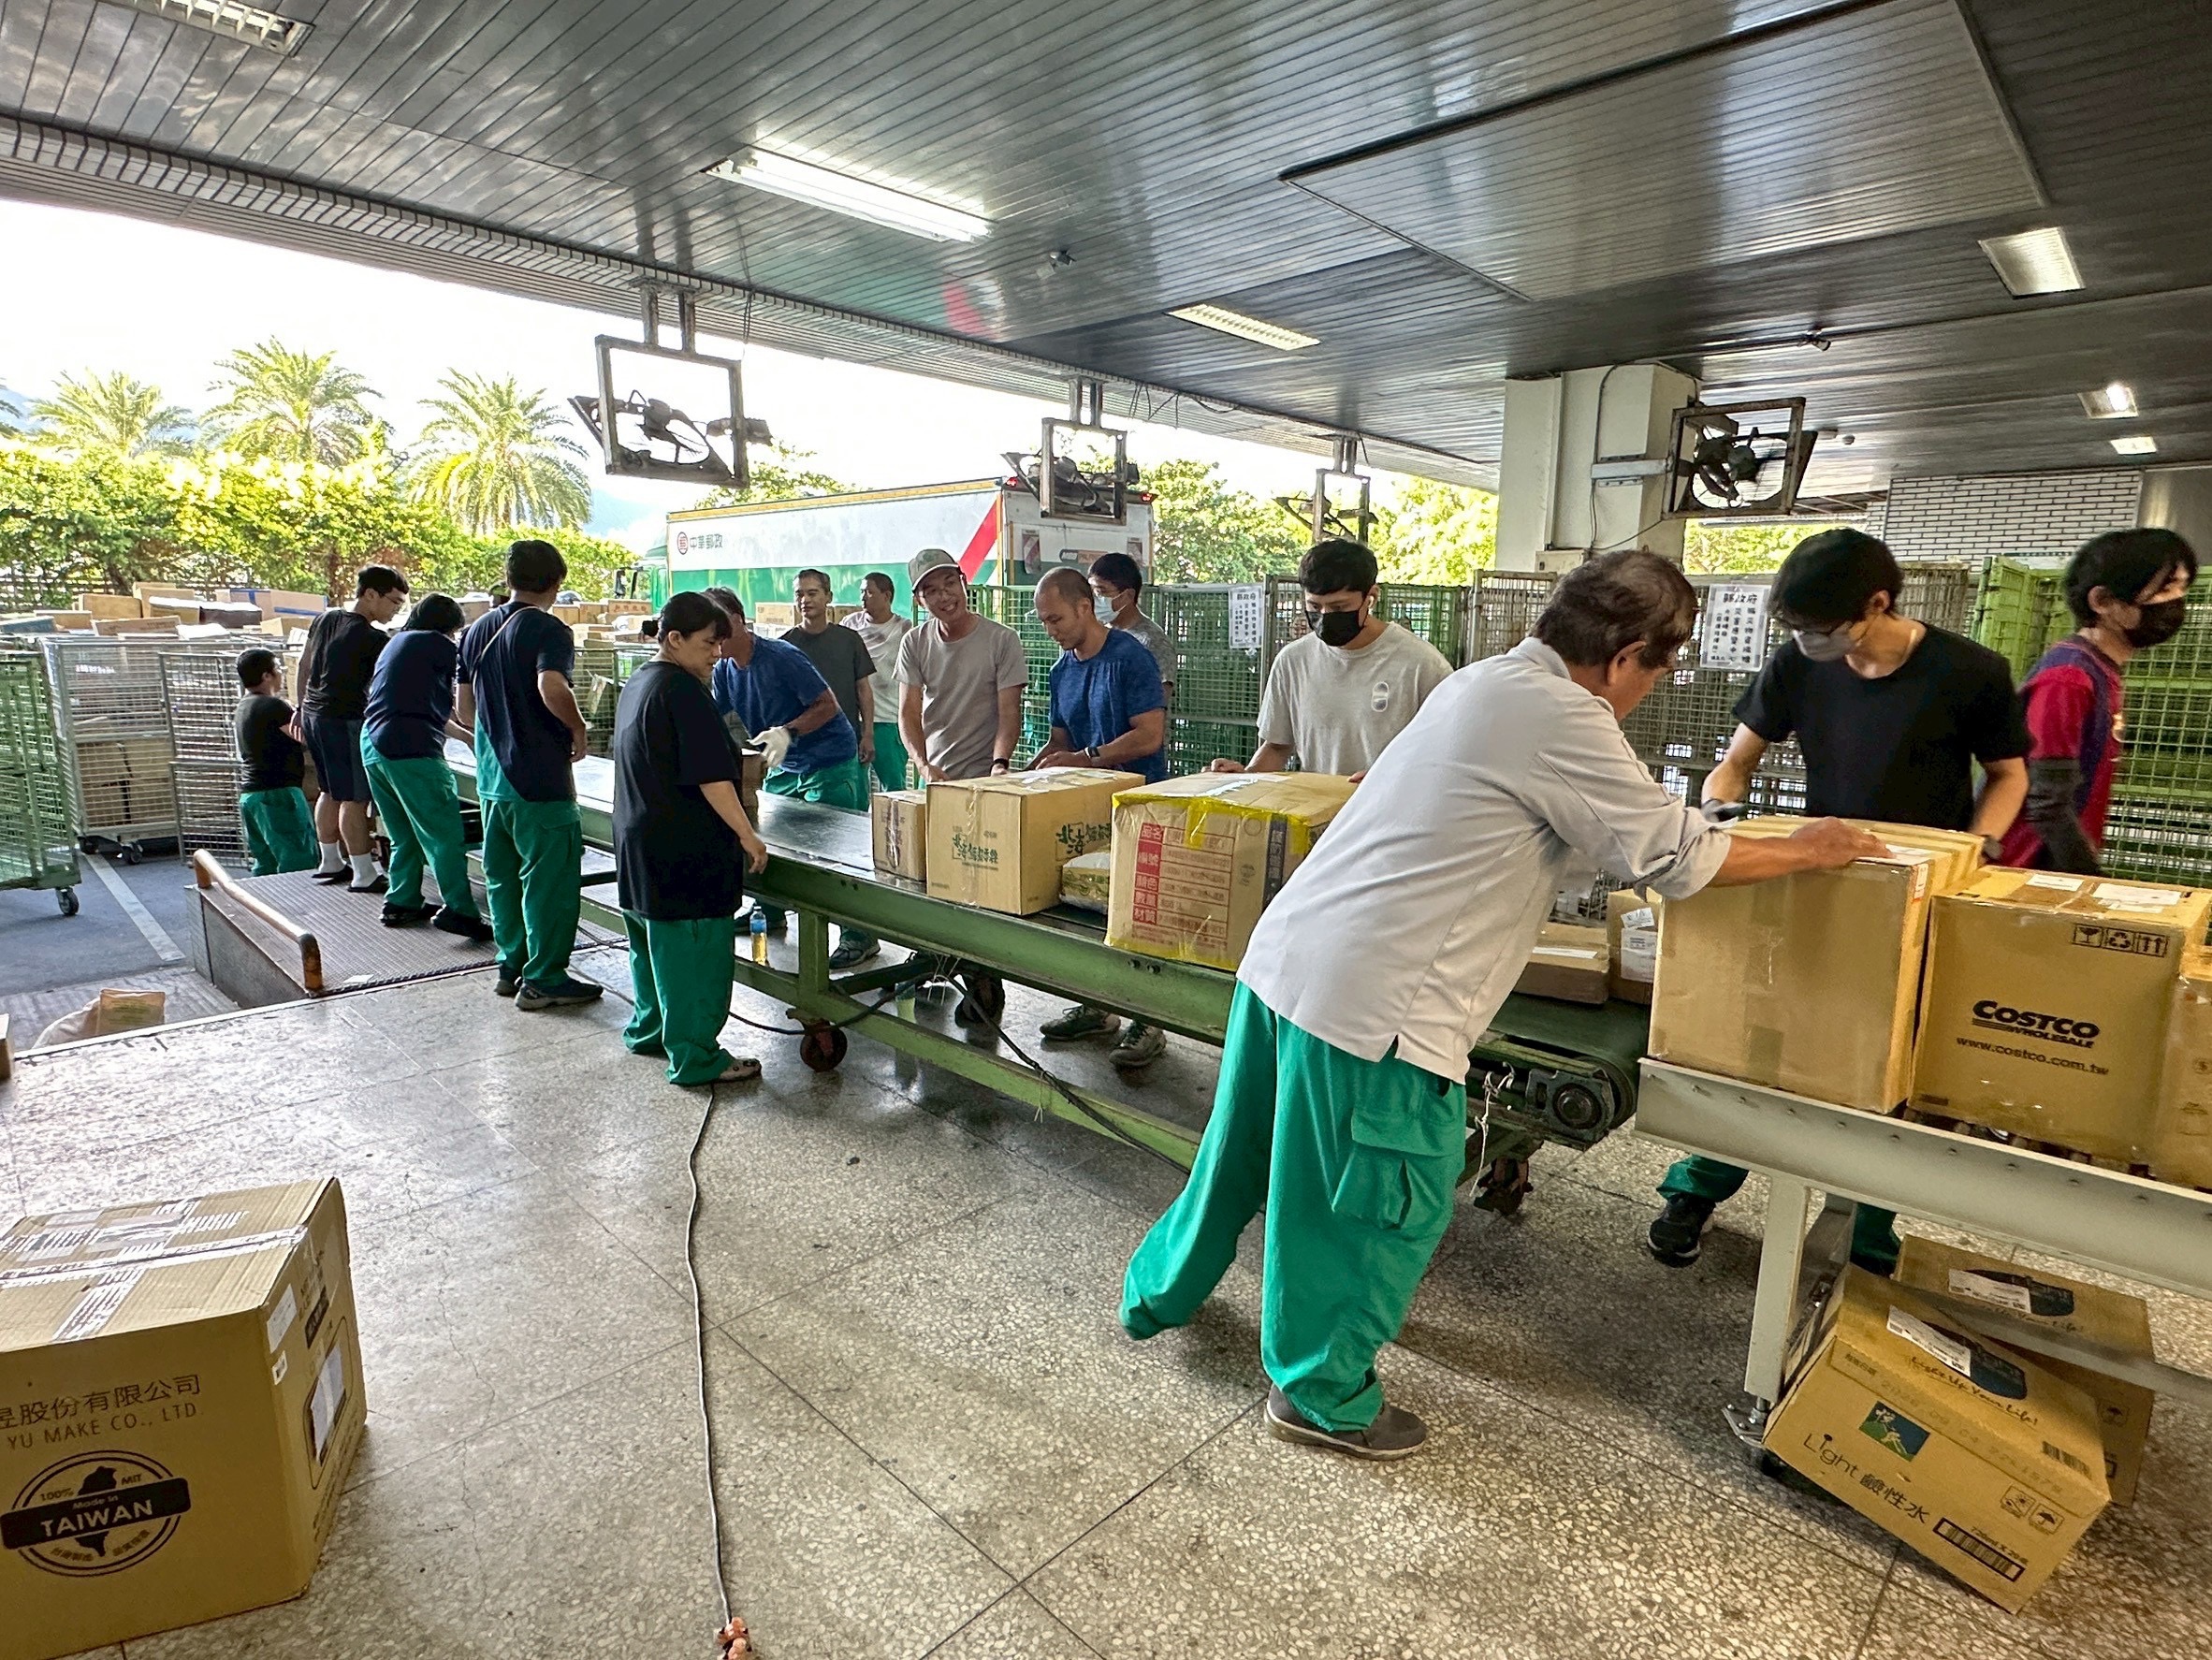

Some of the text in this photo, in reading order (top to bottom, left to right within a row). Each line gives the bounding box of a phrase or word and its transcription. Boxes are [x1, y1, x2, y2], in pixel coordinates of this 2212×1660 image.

[690, 533, 723, 550] 中華郵政
[1141, 824, 1163, 840] 品名
[1136, 876, 1158, 892] 顏色
[1133, 906, 1157, 925] 材質
[1972, 999, 2101, 1039] COSTCO
[2009, 1027, 2095, 1049] WHOLESALE
[1957, 1037, 2109, 1075] www.costco.com.tw
[8, 1432, 33, 1450] YU
[44, 1420, 102, 1444] MAKE
[40, 1474, 142, 1501] 100% MIT
[1803, 1430, 1931, 1525] Light 鹼性水
[73, 1498, 105, 1509] Made
[40, 1499, 153, 1537] TAIWAN
